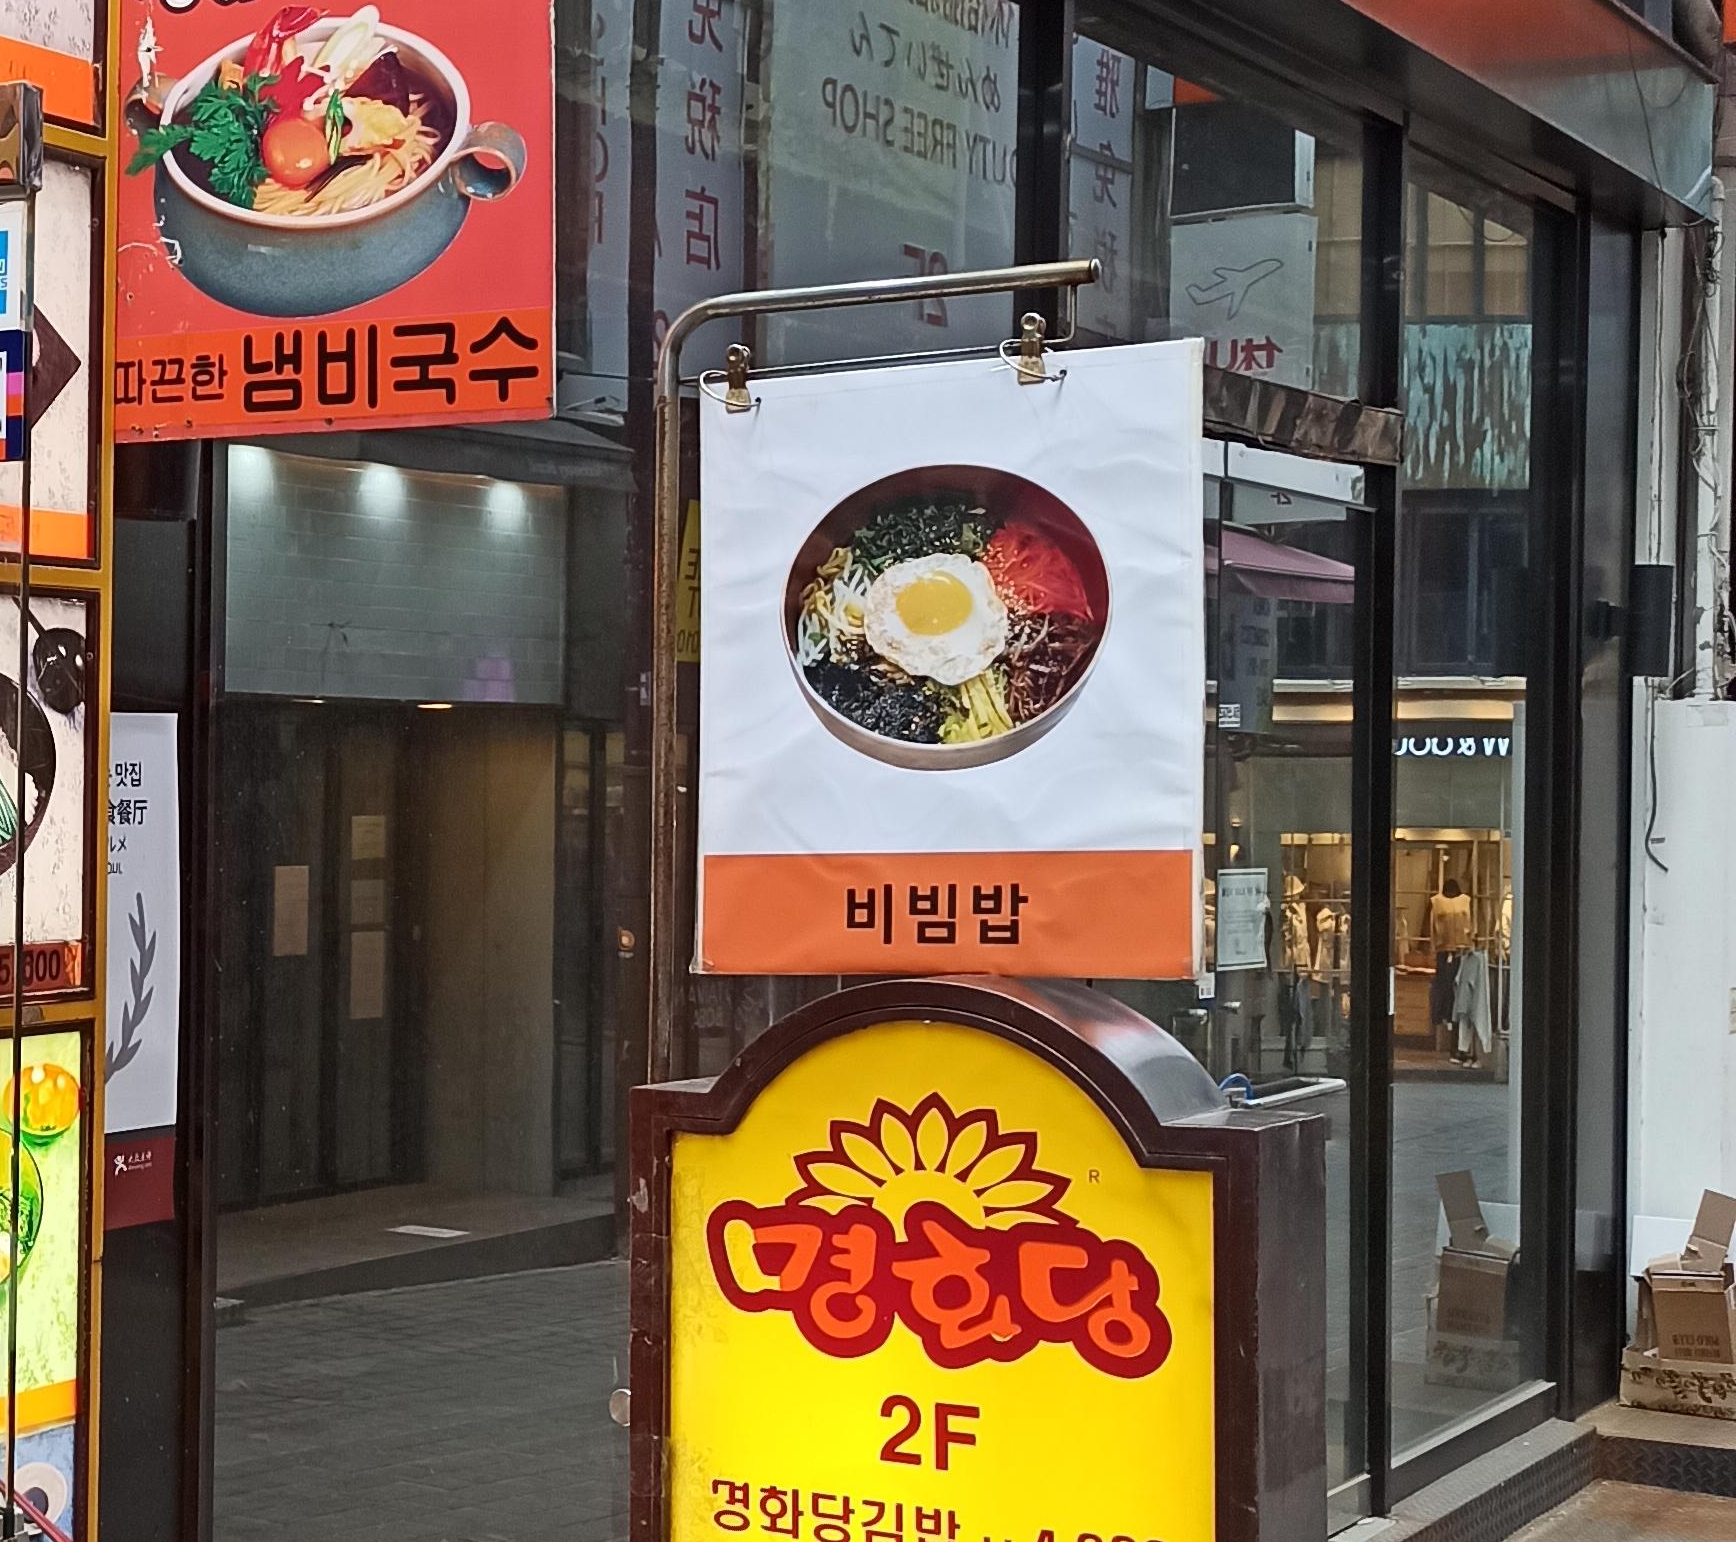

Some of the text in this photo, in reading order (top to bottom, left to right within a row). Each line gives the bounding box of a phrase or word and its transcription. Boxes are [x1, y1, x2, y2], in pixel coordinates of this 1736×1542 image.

[116, 315, 539, 413] 따끈한 냄비국수
[115, 761, 142, 788] 맛집
[845, 882, 1029, 946] 비빔밥
[723, 1217, 1153, 1359] 명화당
[879, 1395, 981, 1472] 2F
